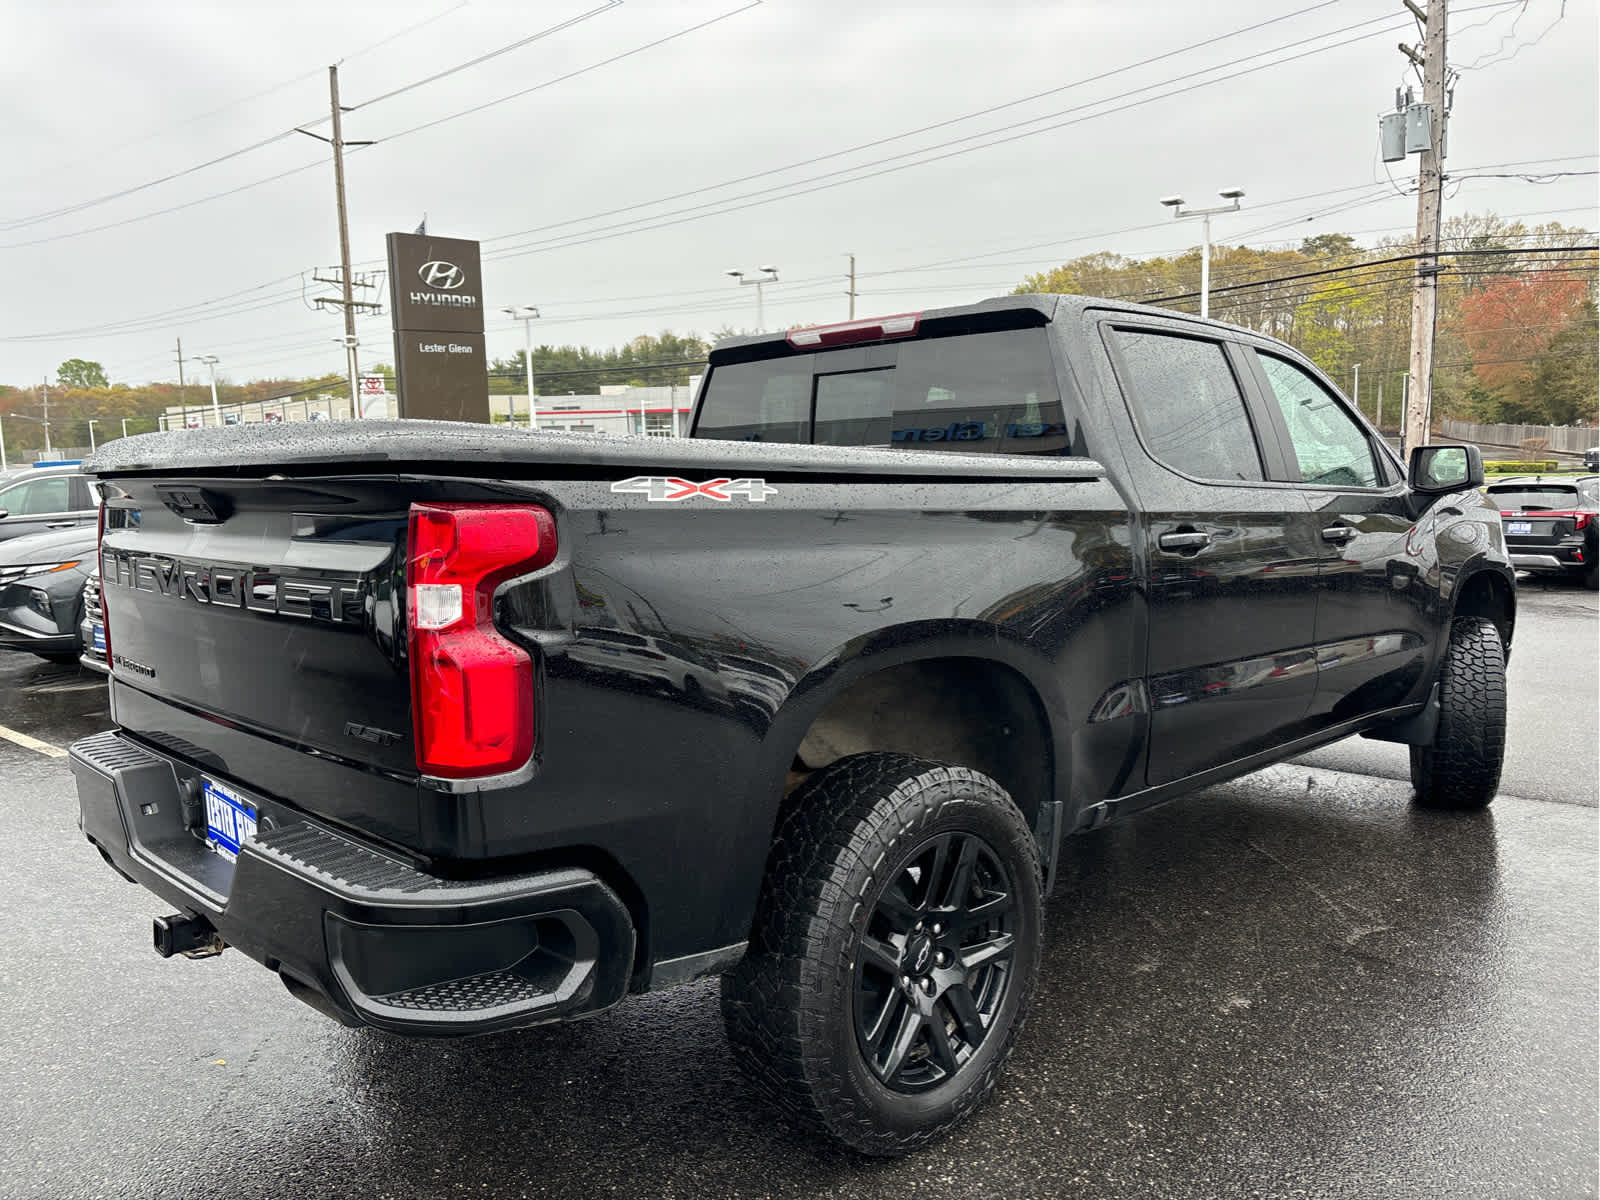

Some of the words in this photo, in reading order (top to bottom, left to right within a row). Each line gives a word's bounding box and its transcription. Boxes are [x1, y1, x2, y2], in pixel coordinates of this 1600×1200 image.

[410, 291, 477, 307] HYUNDAI
[419, 343, 446, 353] Lester
[448, 343, 473, 354] Glenn
[102, 552, 360, 622] CHEVROLET
[343, 721, 404, 746] RST
[204, 791, 237, 841] LESTER
